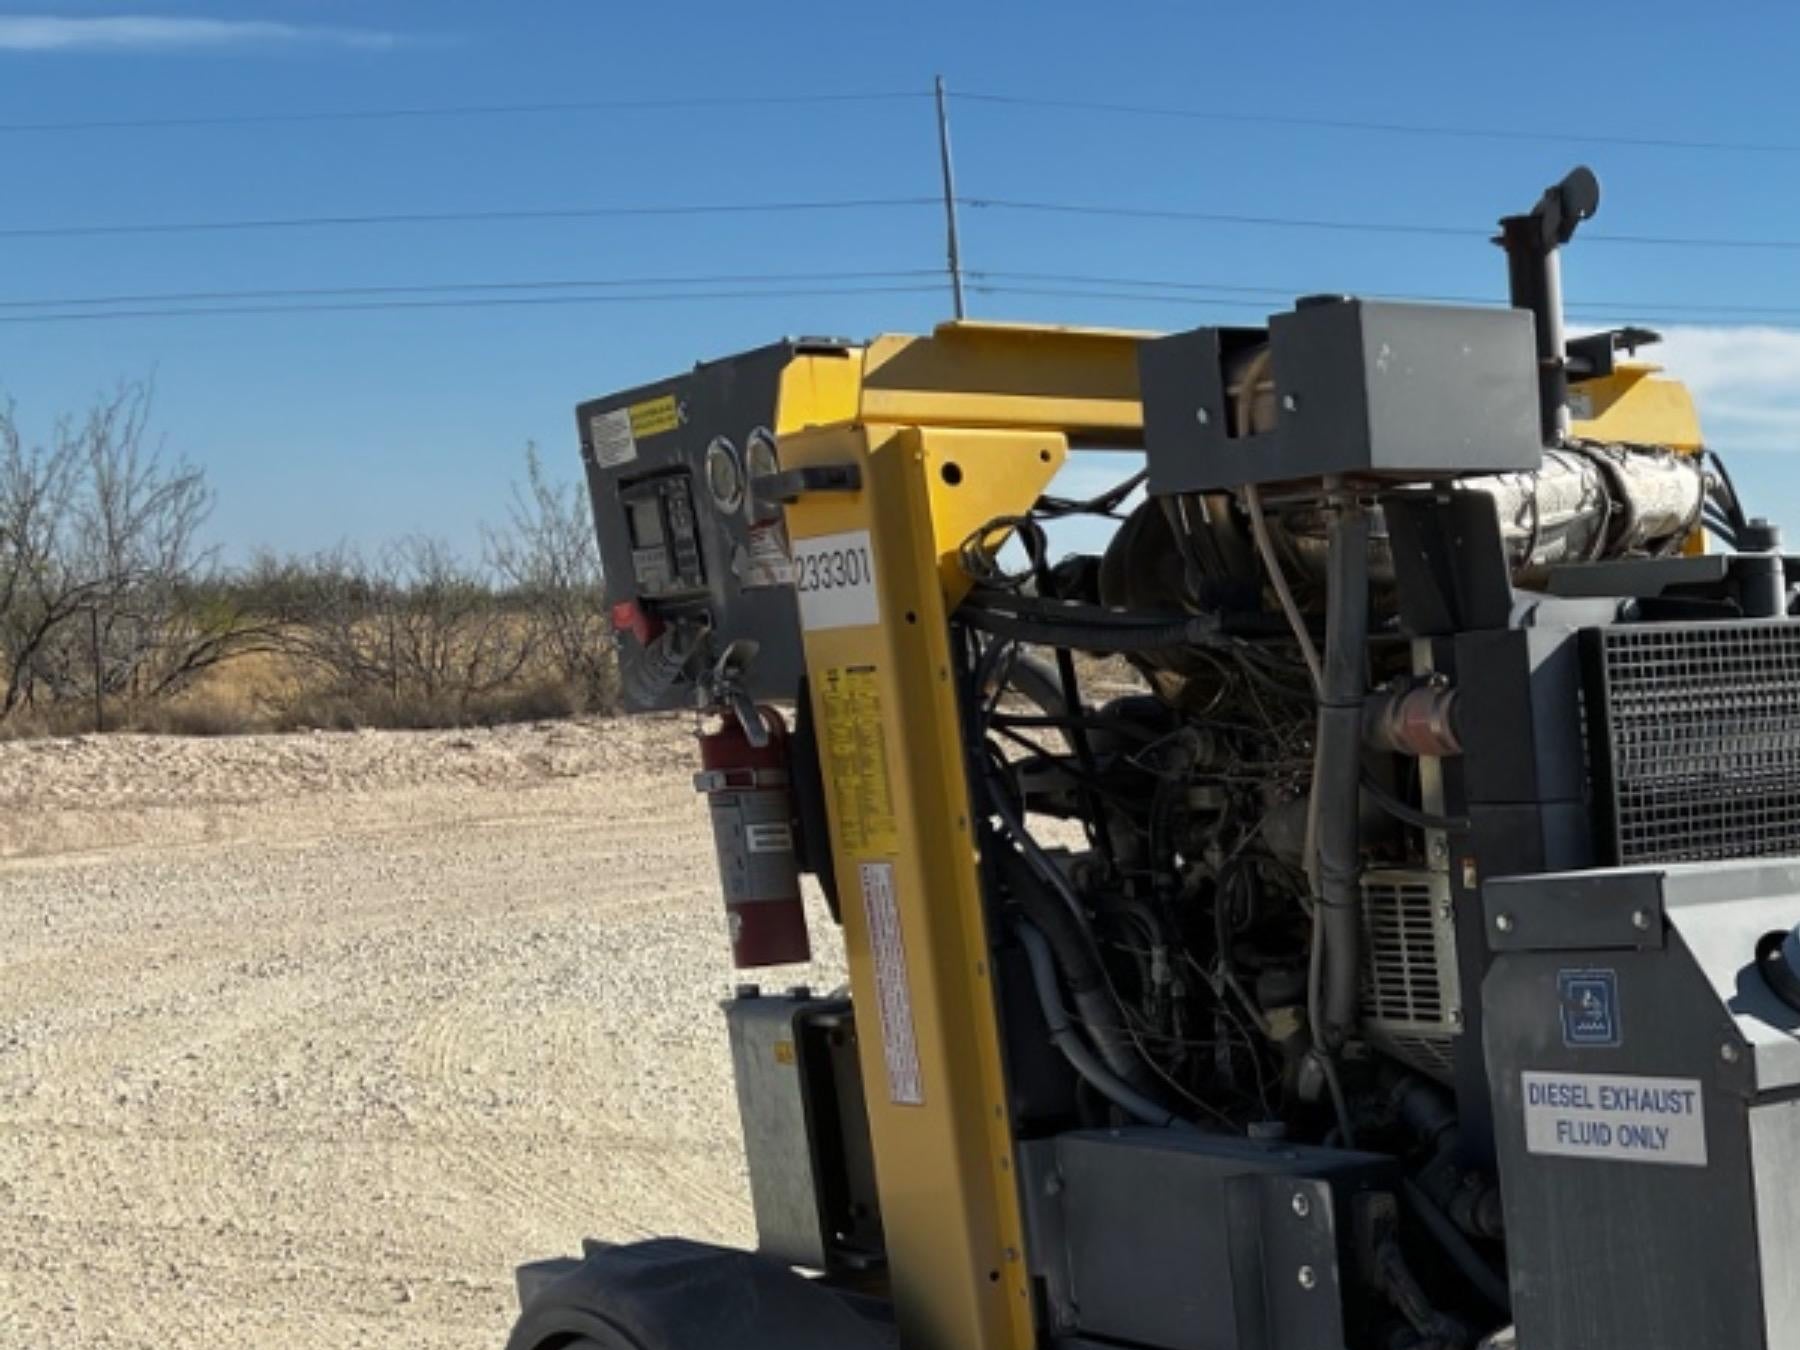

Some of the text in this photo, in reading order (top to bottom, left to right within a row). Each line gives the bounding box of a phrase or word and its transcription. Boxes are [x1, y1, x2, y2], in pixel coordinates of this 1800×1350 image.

[795, 547, 871, 593] 233301
[1528, 1083, 1695, 1115] DIESEL EXHAUST
[1556, 1119, 1669, 1151] FLUID ONLY
